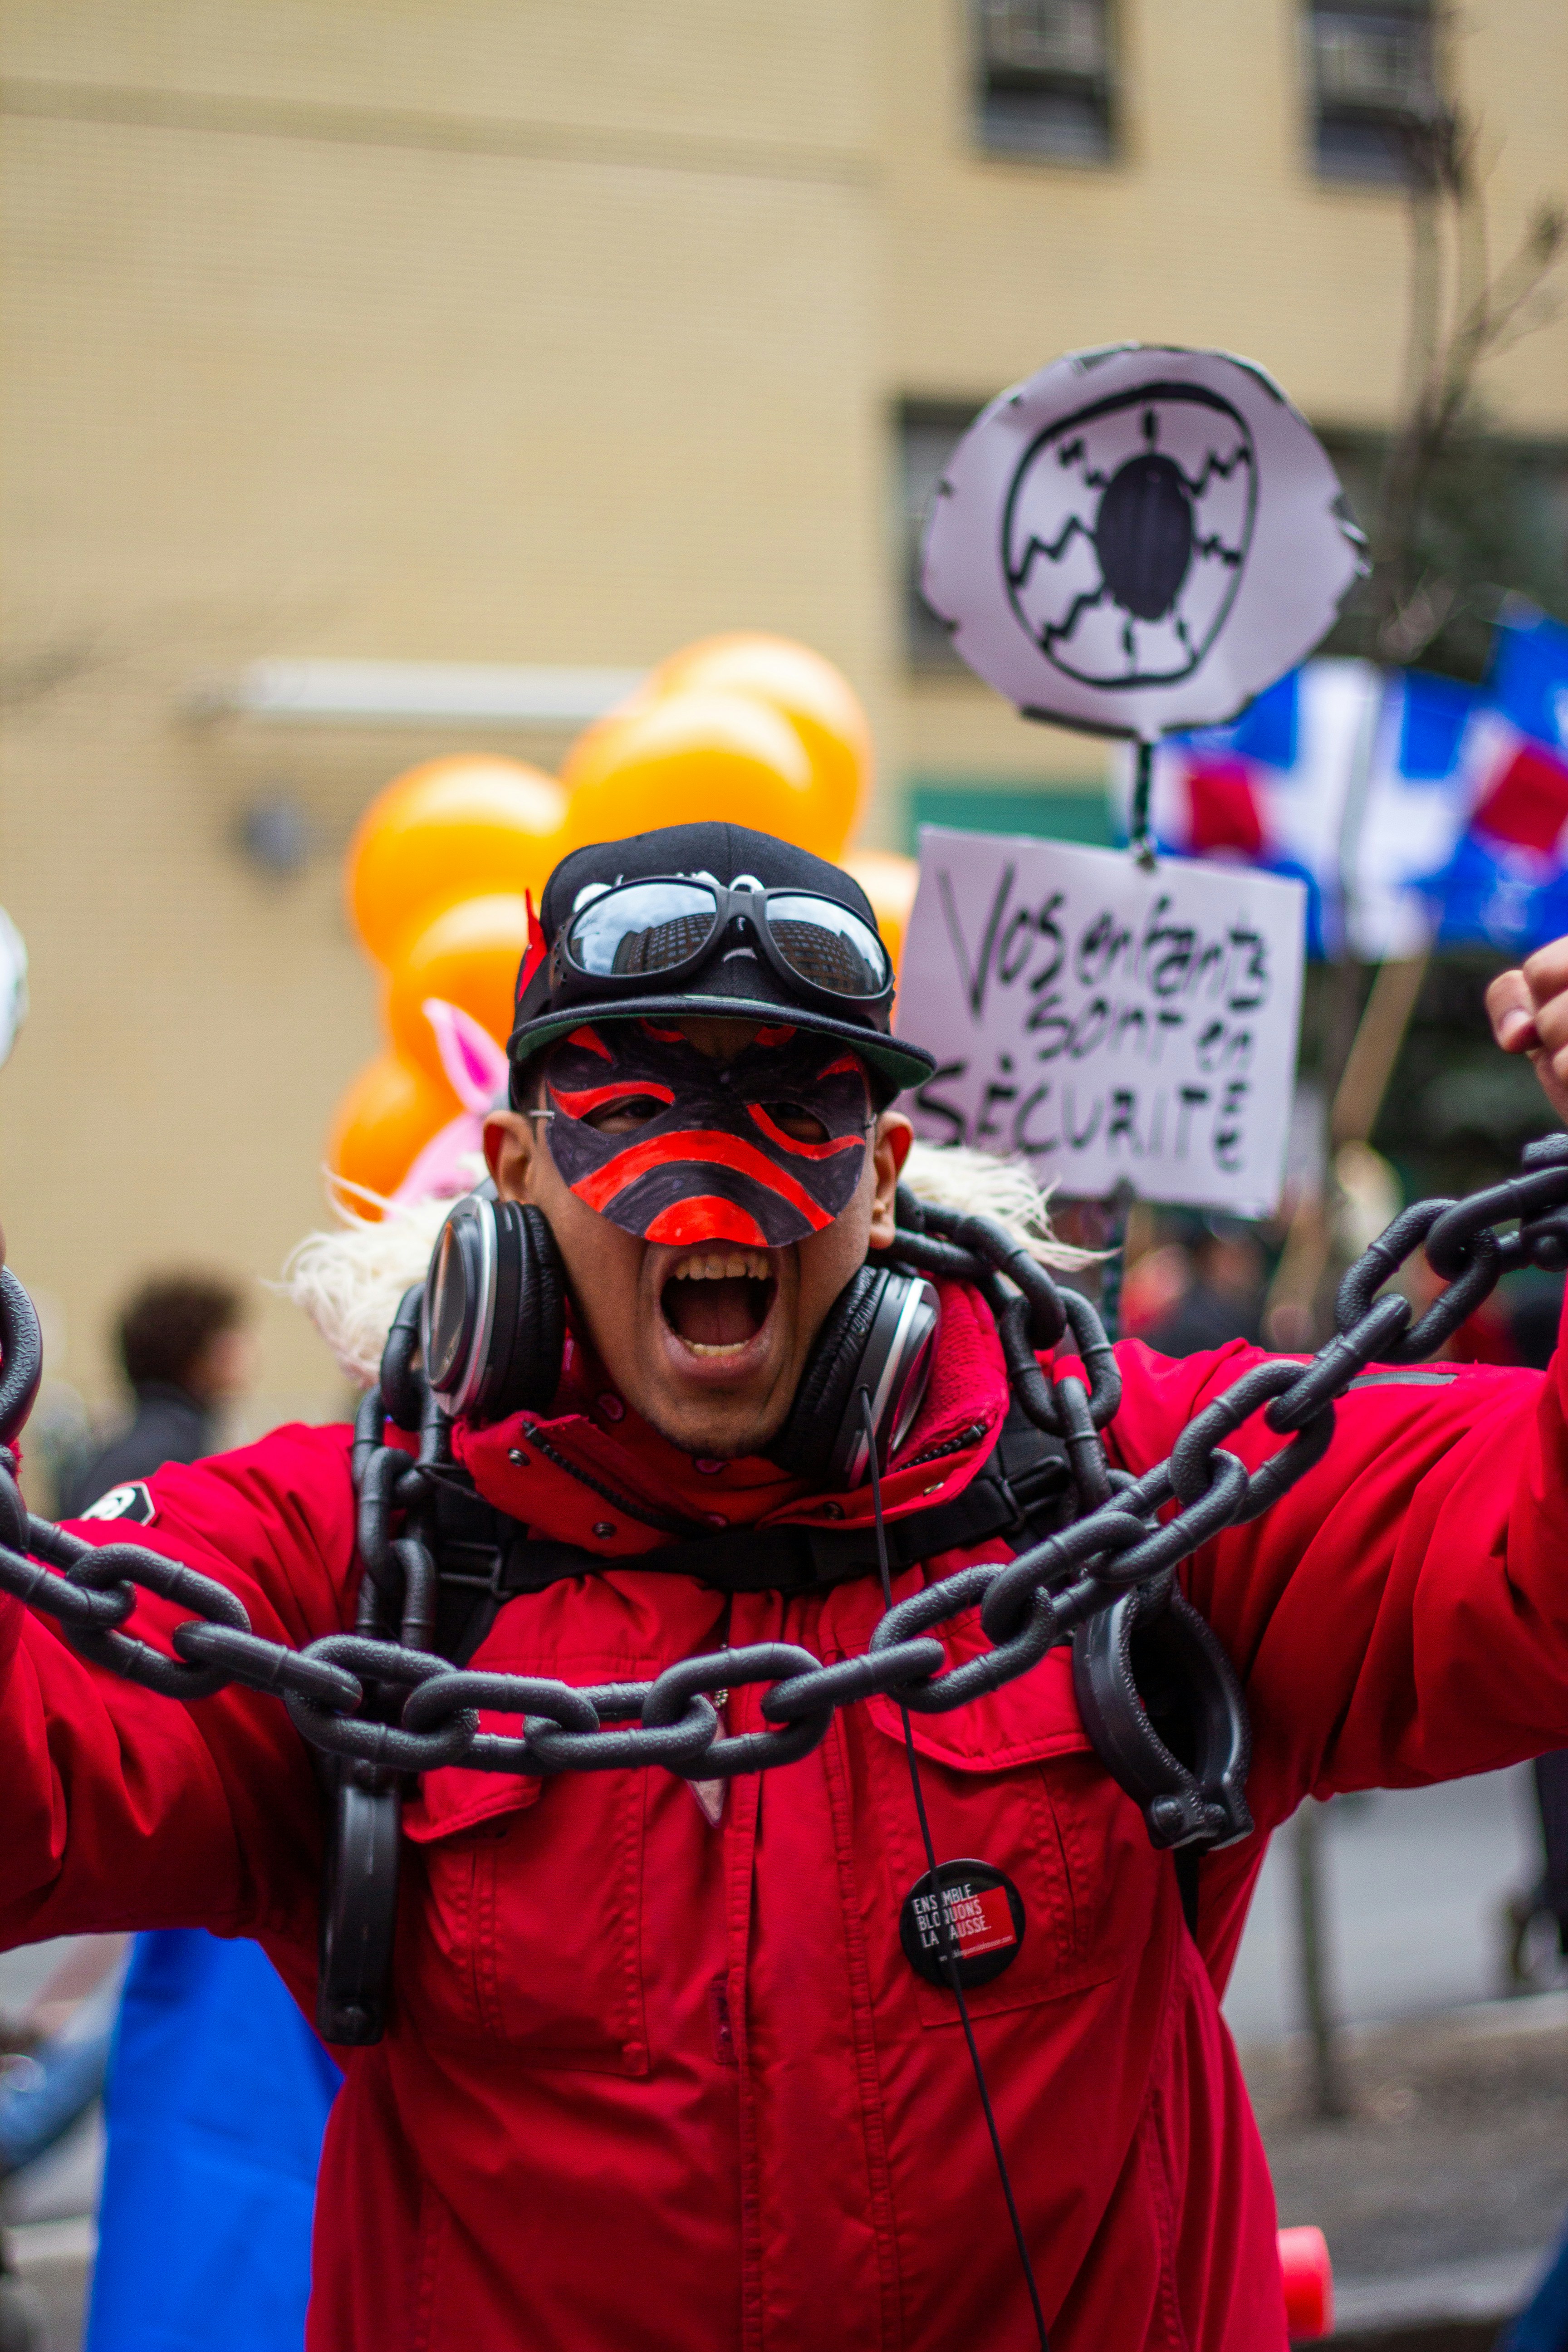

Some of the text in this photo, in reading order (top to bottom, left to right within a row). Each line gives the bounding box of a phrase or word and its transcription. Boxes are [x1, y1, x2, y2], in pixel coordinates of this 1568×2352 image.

[935, 860, 1067, 1024] Vos
[1196, 1020, 1252, 1071] en
[920, 1930, 940, 1948] LA
